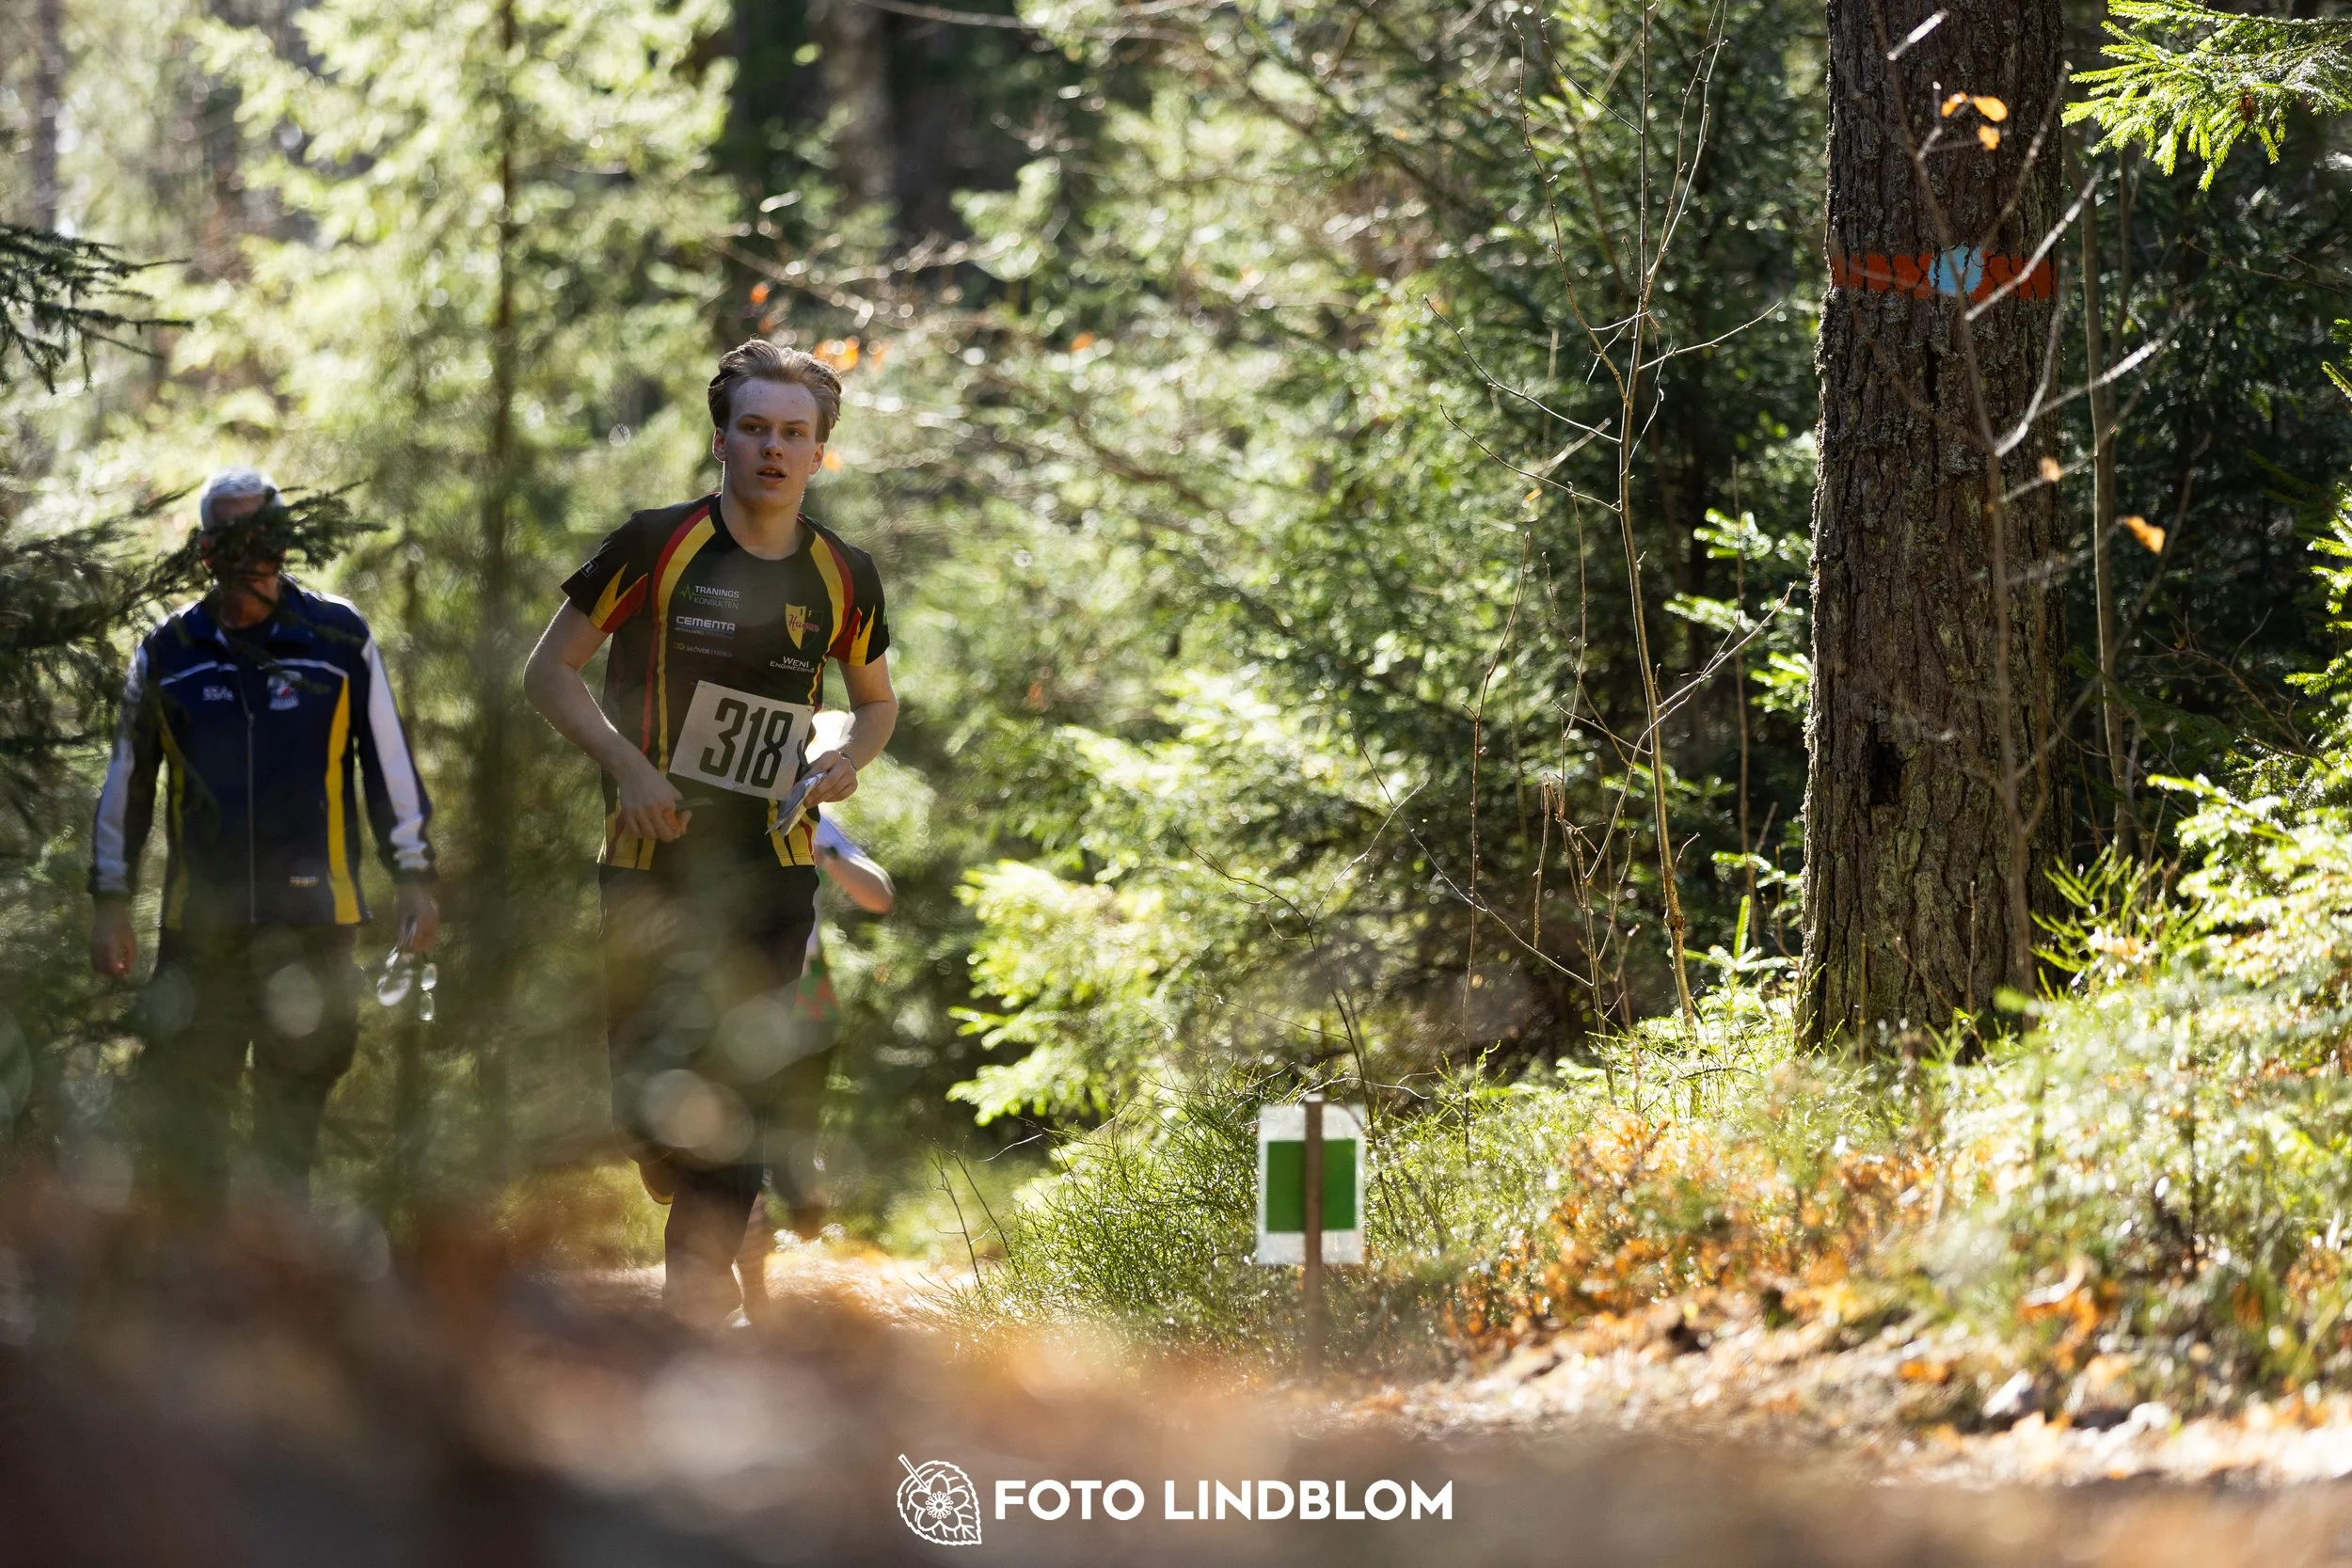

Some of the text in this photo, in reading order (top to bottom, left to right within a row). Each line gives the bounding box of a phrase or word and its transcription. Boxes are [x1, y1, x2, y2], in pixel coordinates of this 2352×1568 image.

[693, 596, 739, 610] KONSULTEN
[675, 615, 736, 632] CEMENTA
[783, 656, 810, 669] WENI
[699, 697, 794, 789] 318
